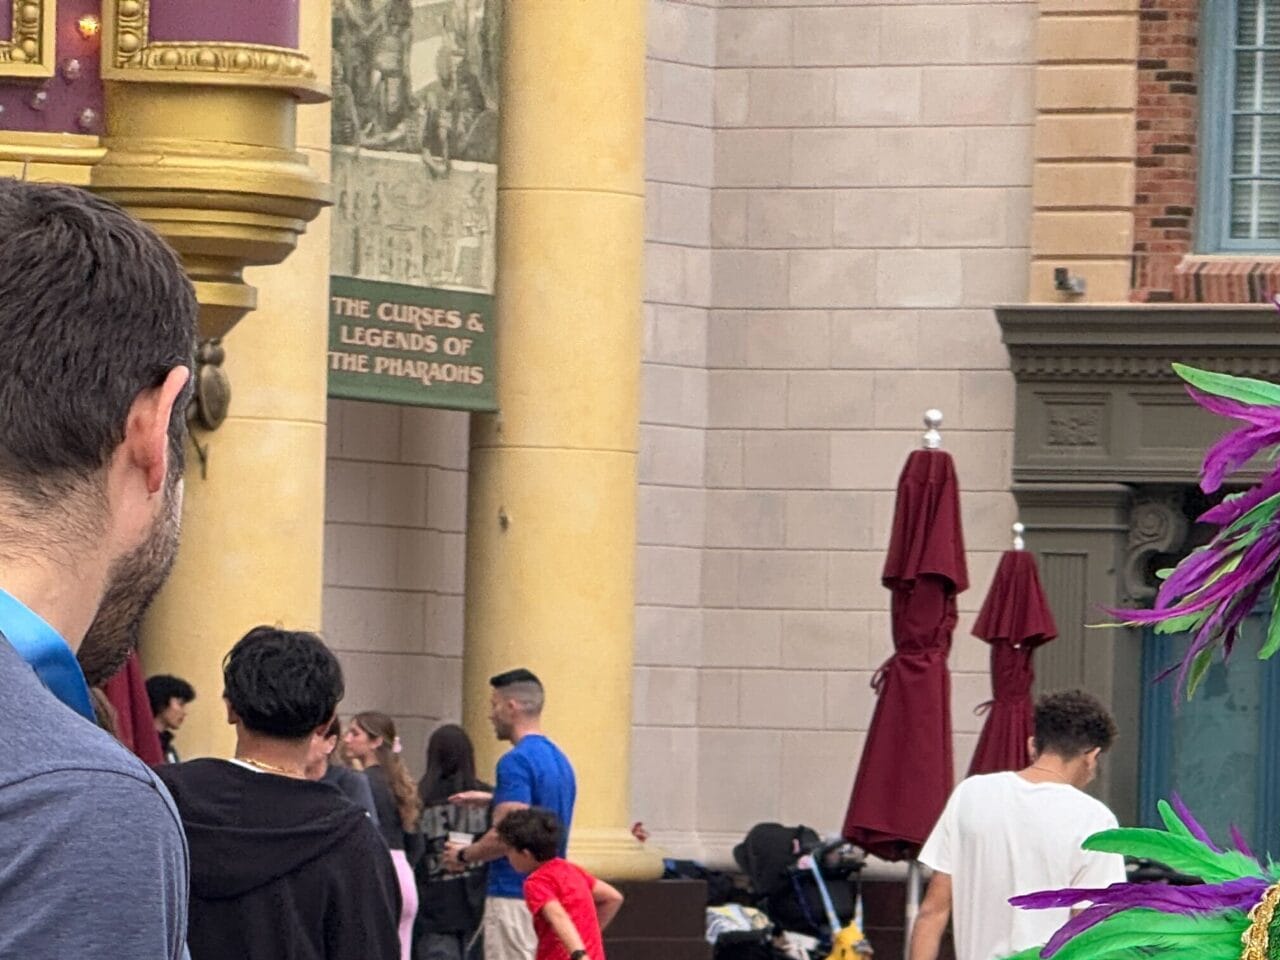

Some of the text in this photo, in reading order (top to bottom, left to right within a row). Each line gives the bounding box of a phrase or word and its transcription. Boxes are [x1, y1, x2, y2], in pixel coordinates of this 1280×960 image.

[332, 297, 485, 333] THE CURSES &
[341, 326, 473, 356] LEGENDS OF
[328, 351, 485, 386] THE PHARAOHS
